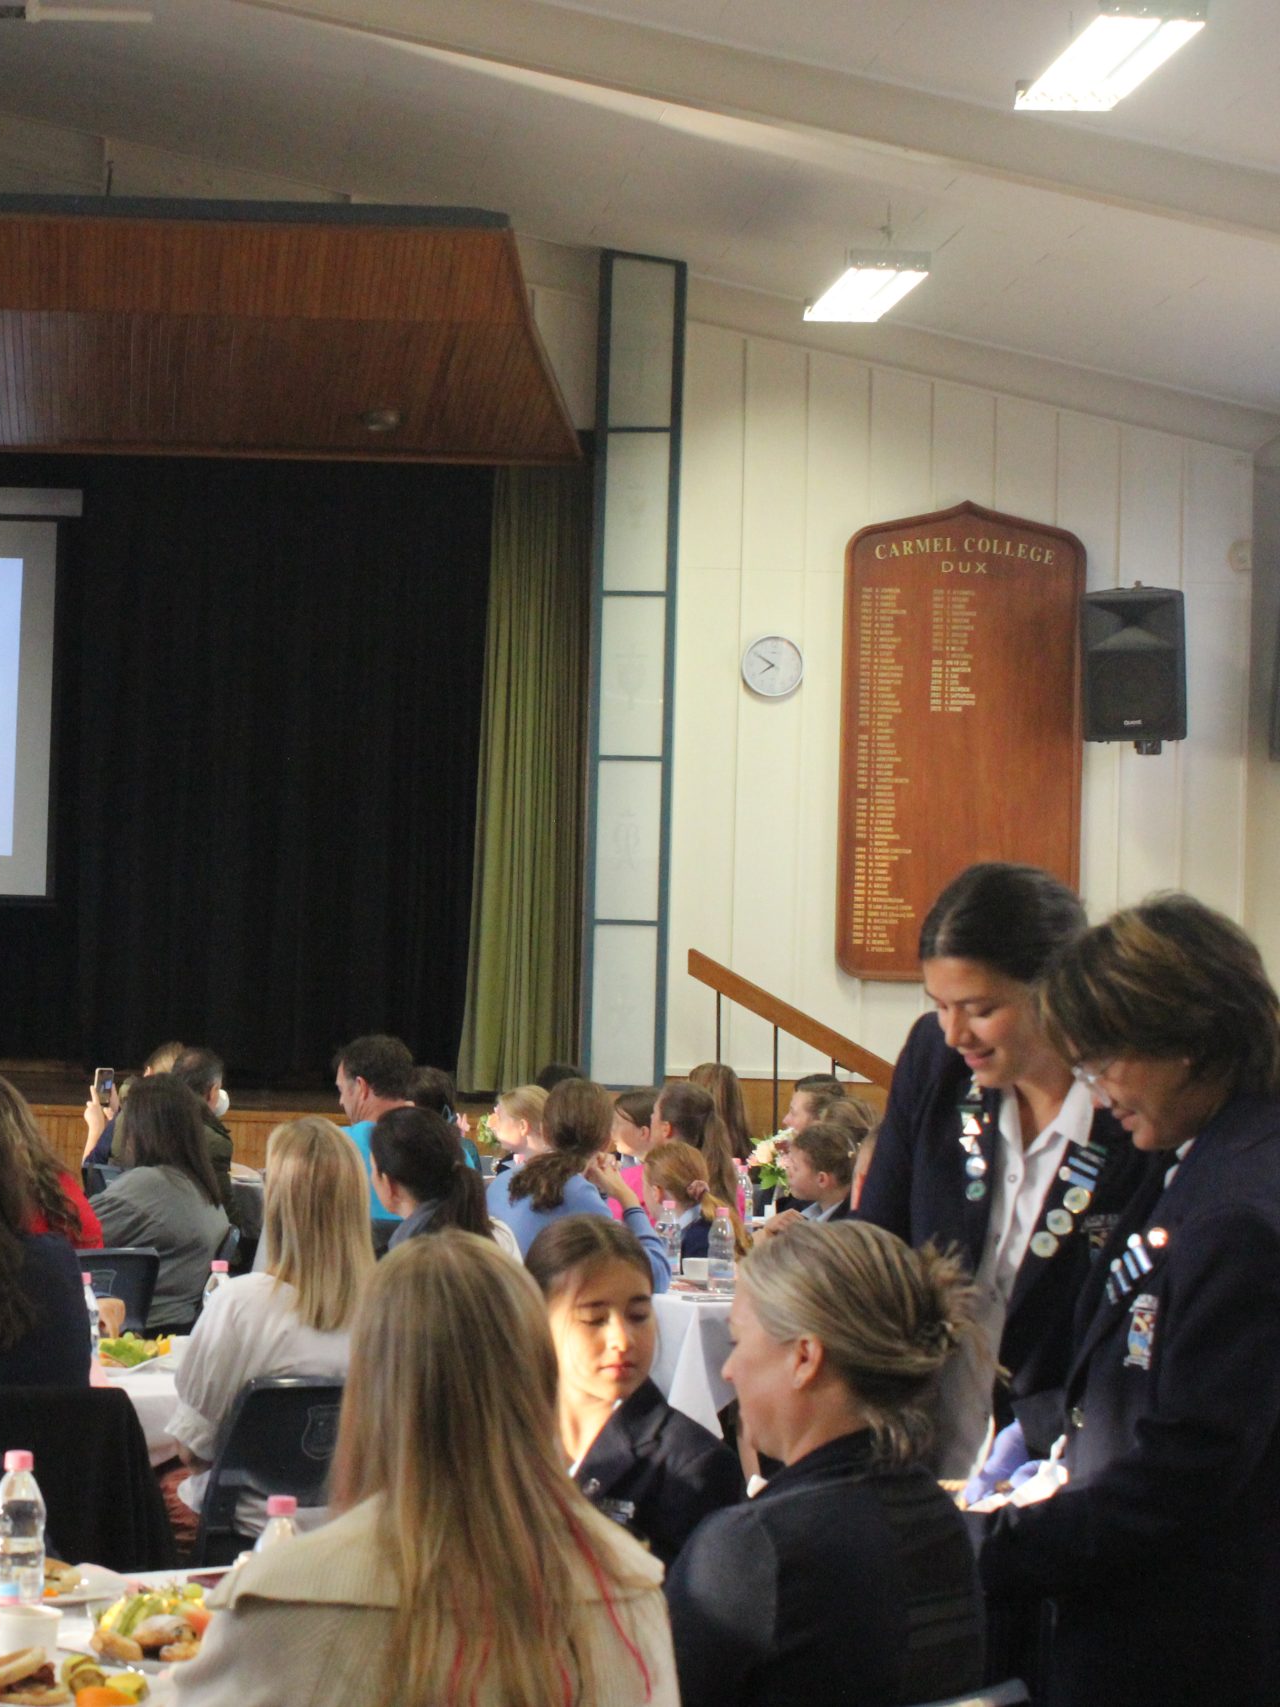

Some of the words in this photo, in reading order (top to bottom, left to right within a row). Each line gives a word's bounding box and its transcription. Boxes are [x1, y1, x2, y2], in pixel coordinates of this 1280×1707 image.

[875, 537, 956, 560] CARMEL
[963, 538, 1055, 565] COLLEGE
[941, 561, 987, 574] DUX
